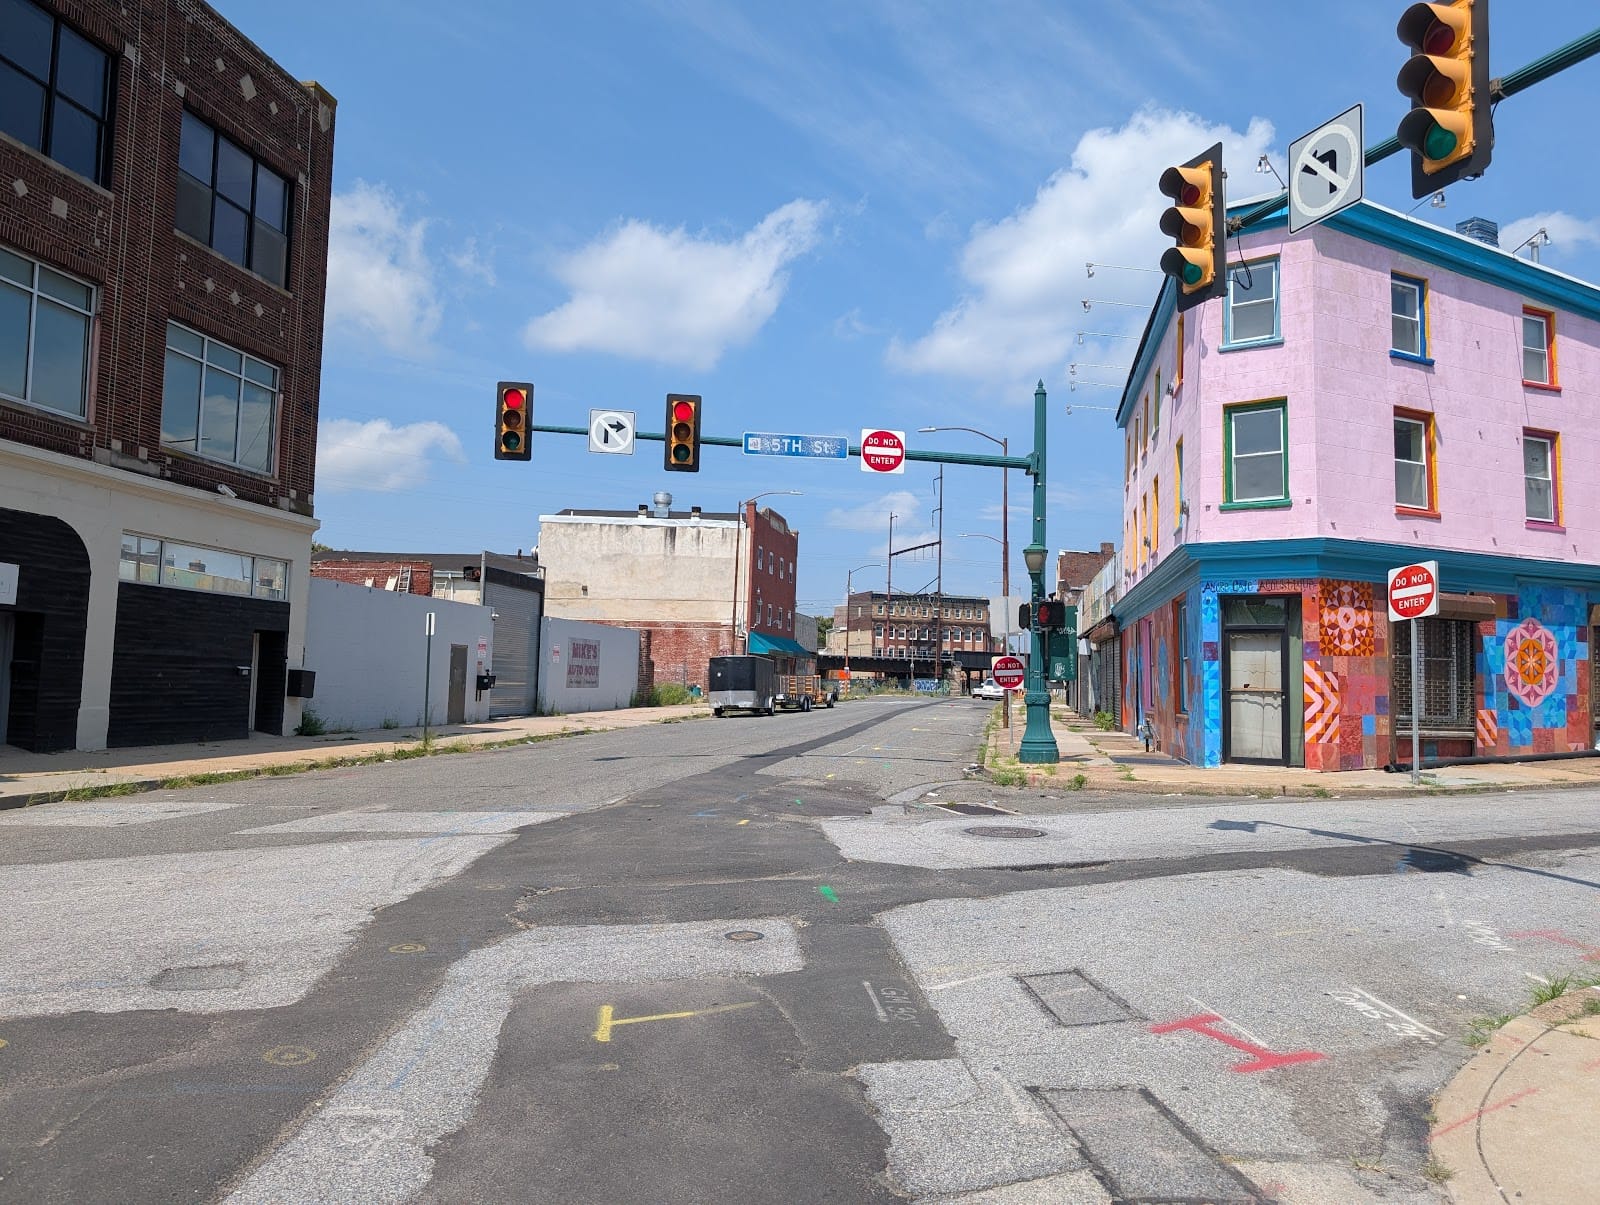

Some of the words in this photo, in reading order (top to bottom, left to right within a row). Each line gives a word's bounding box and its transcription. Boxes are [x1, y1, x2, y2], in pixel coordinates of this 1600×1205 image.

[868, 437, 879, 445] DO
[883, 438, 899, 447] NOT
[870, 456, 896, 465] ENTER
[1395, 577, 1407, 588] DO
[1411, 572, 1429, 585] NOT
[1398, 597, 1426, 610] ENTER
[572, 642, 597, 660] MIKE'S
[567, 664, 584, 676] AUTO
